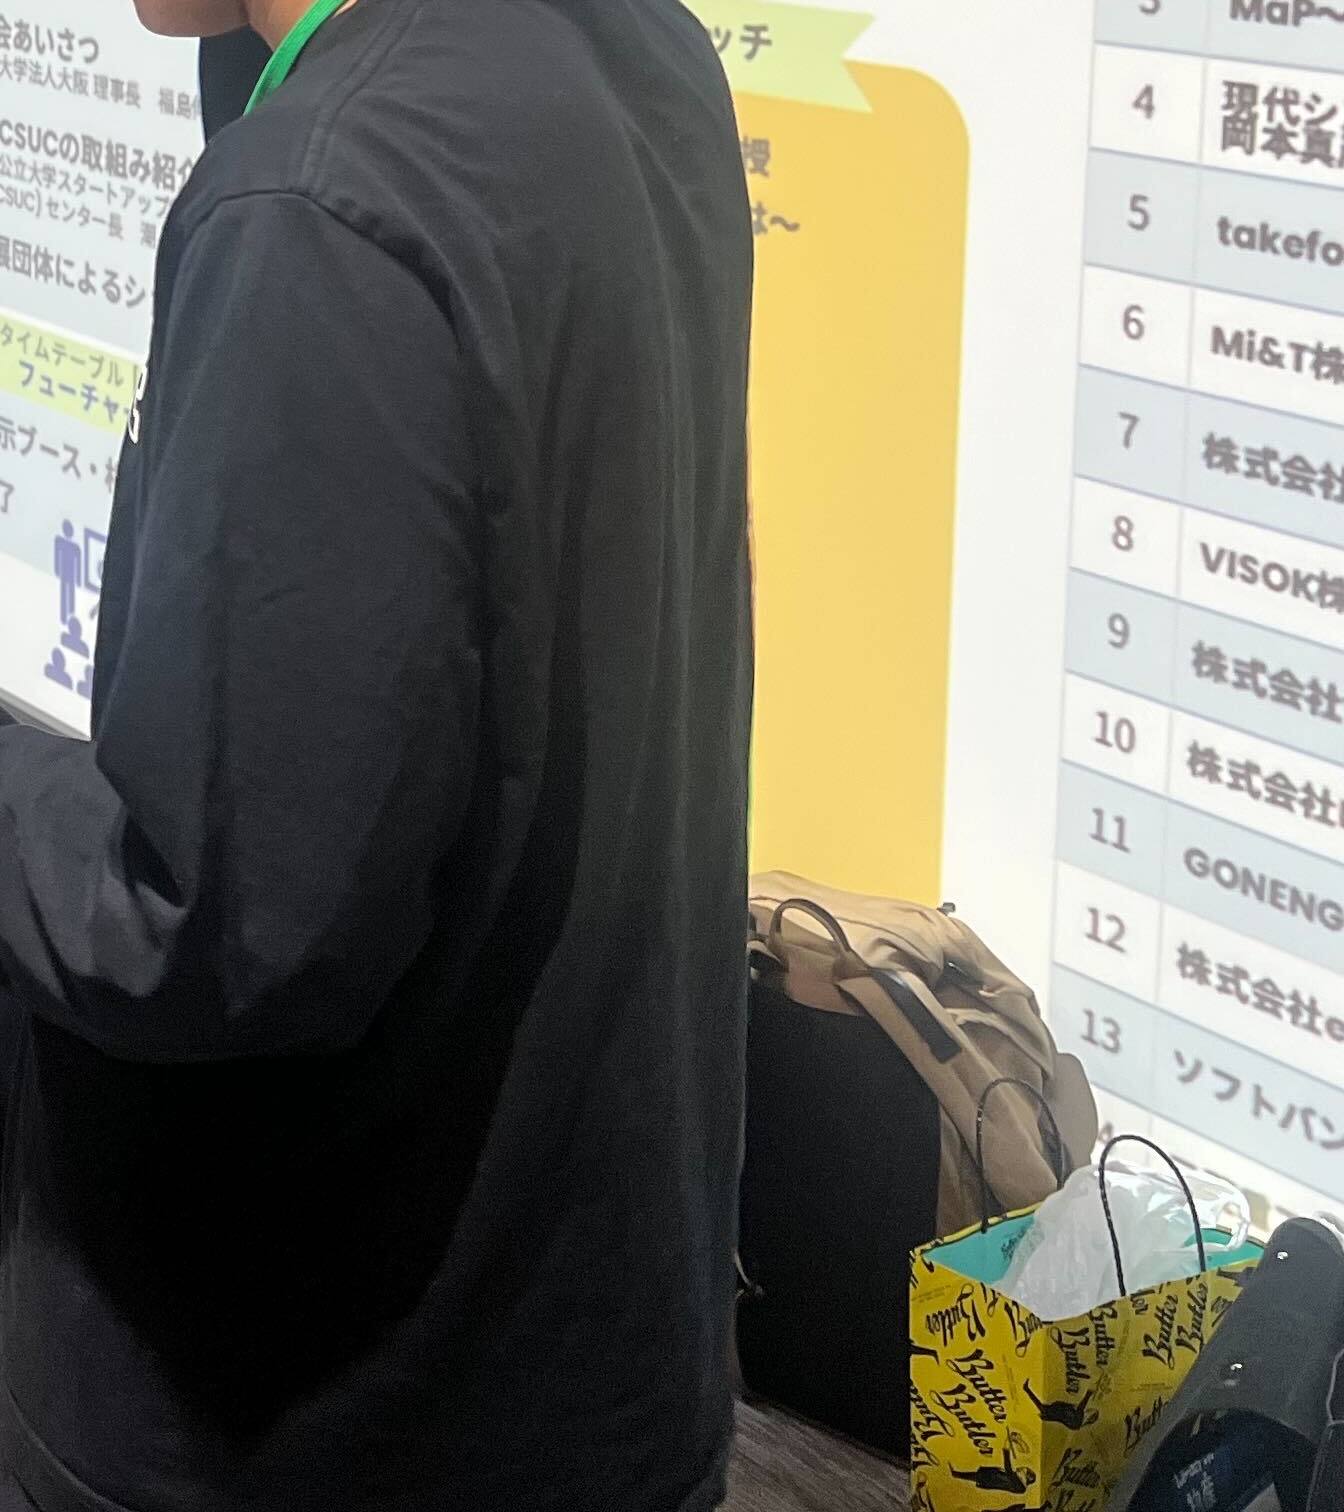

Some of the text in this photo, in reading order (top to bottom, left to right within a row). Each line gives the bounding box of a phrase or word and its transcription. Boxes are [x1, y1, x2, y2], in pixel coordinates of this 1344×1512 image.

[1131, 83, 1156, 120] 4
[1126, 193, 1151, 231] 5
[1121, 304, 1146, 340] 6
[1117, 411, 1141, 449] 7
[1111, 514, 1135, 552] 8
[1106, 612, 1131, 650] 9
[1093, 711, 1137, 755] 10
[1088, 807, 1132, 853] 11
[1084, 906, 1127, 955] 12
[1079, 1007, 1123, 1056] 13
